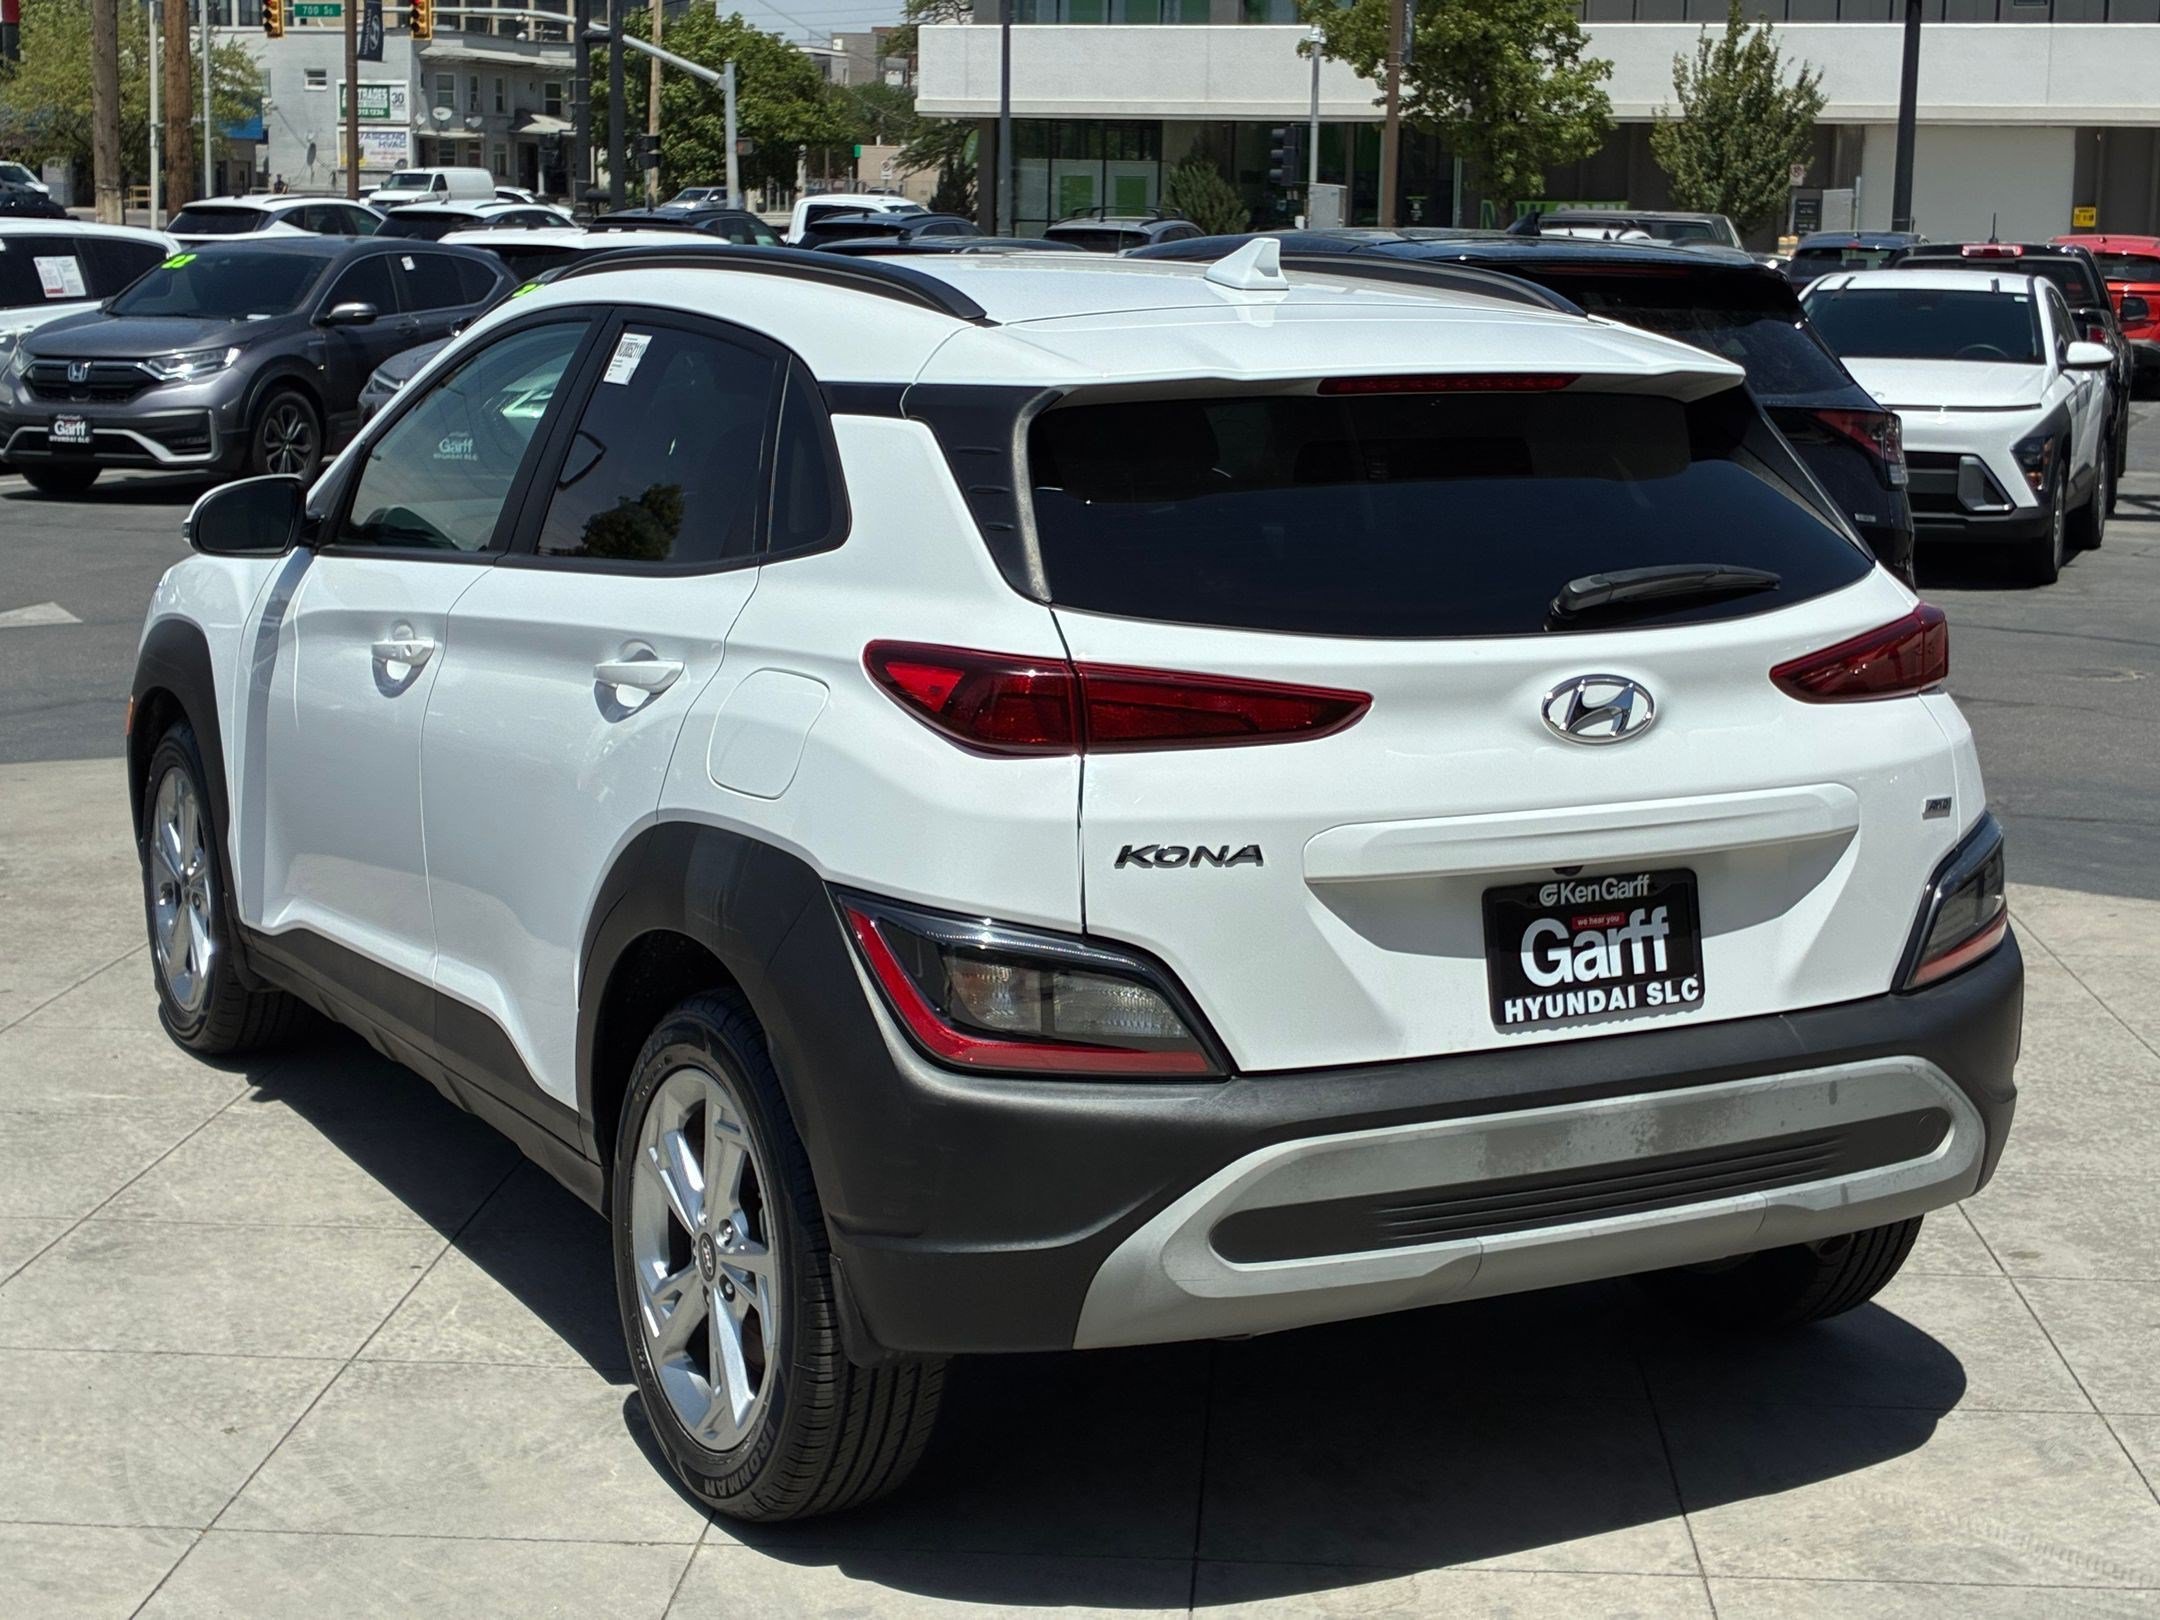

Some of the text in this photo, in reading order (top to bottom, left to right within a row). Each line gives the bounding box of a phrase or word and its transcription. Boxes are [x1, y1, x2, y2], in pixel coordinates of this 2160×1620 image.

[391, 91, 405, 105] 30
[54, 420, 86, 436] Garff
[1114, 844, 1264, 869] KONA
[1560, 874, 1650, 904] Ken Garff
[1577, 915, 1620, 926] we hear you
[1520, 905, 1669, 988] Garff
[1504, 977, 1699, 1023] HYUNDAI SLC
[704, 1418, 777, 1497] IRONMAN
